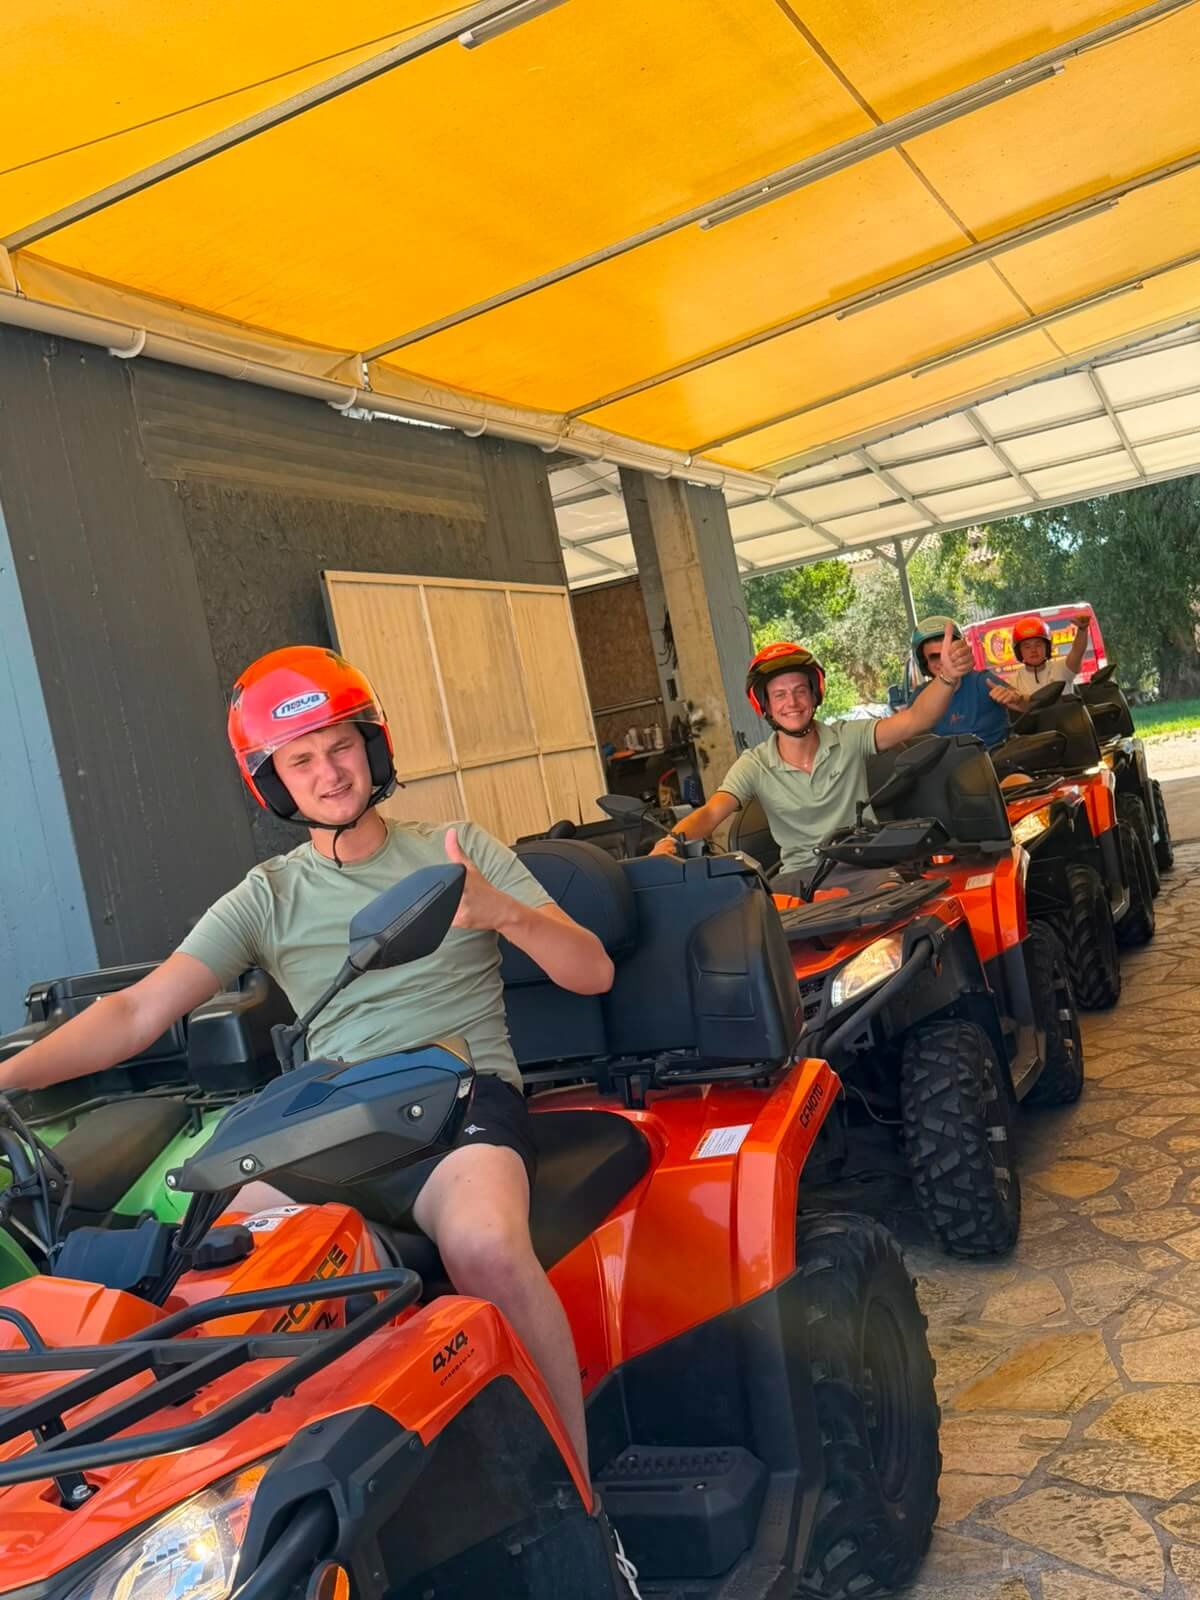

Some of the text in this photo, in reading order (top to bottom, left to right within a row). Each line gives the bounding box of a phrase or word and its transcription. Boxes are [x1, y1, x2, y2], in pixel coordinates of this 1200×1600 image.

[799, 1083, 823, 1129] CFMOTO
[272, 1243, 349, 1334] FOCE
[432, 1329, 468, 1373] 4X4
